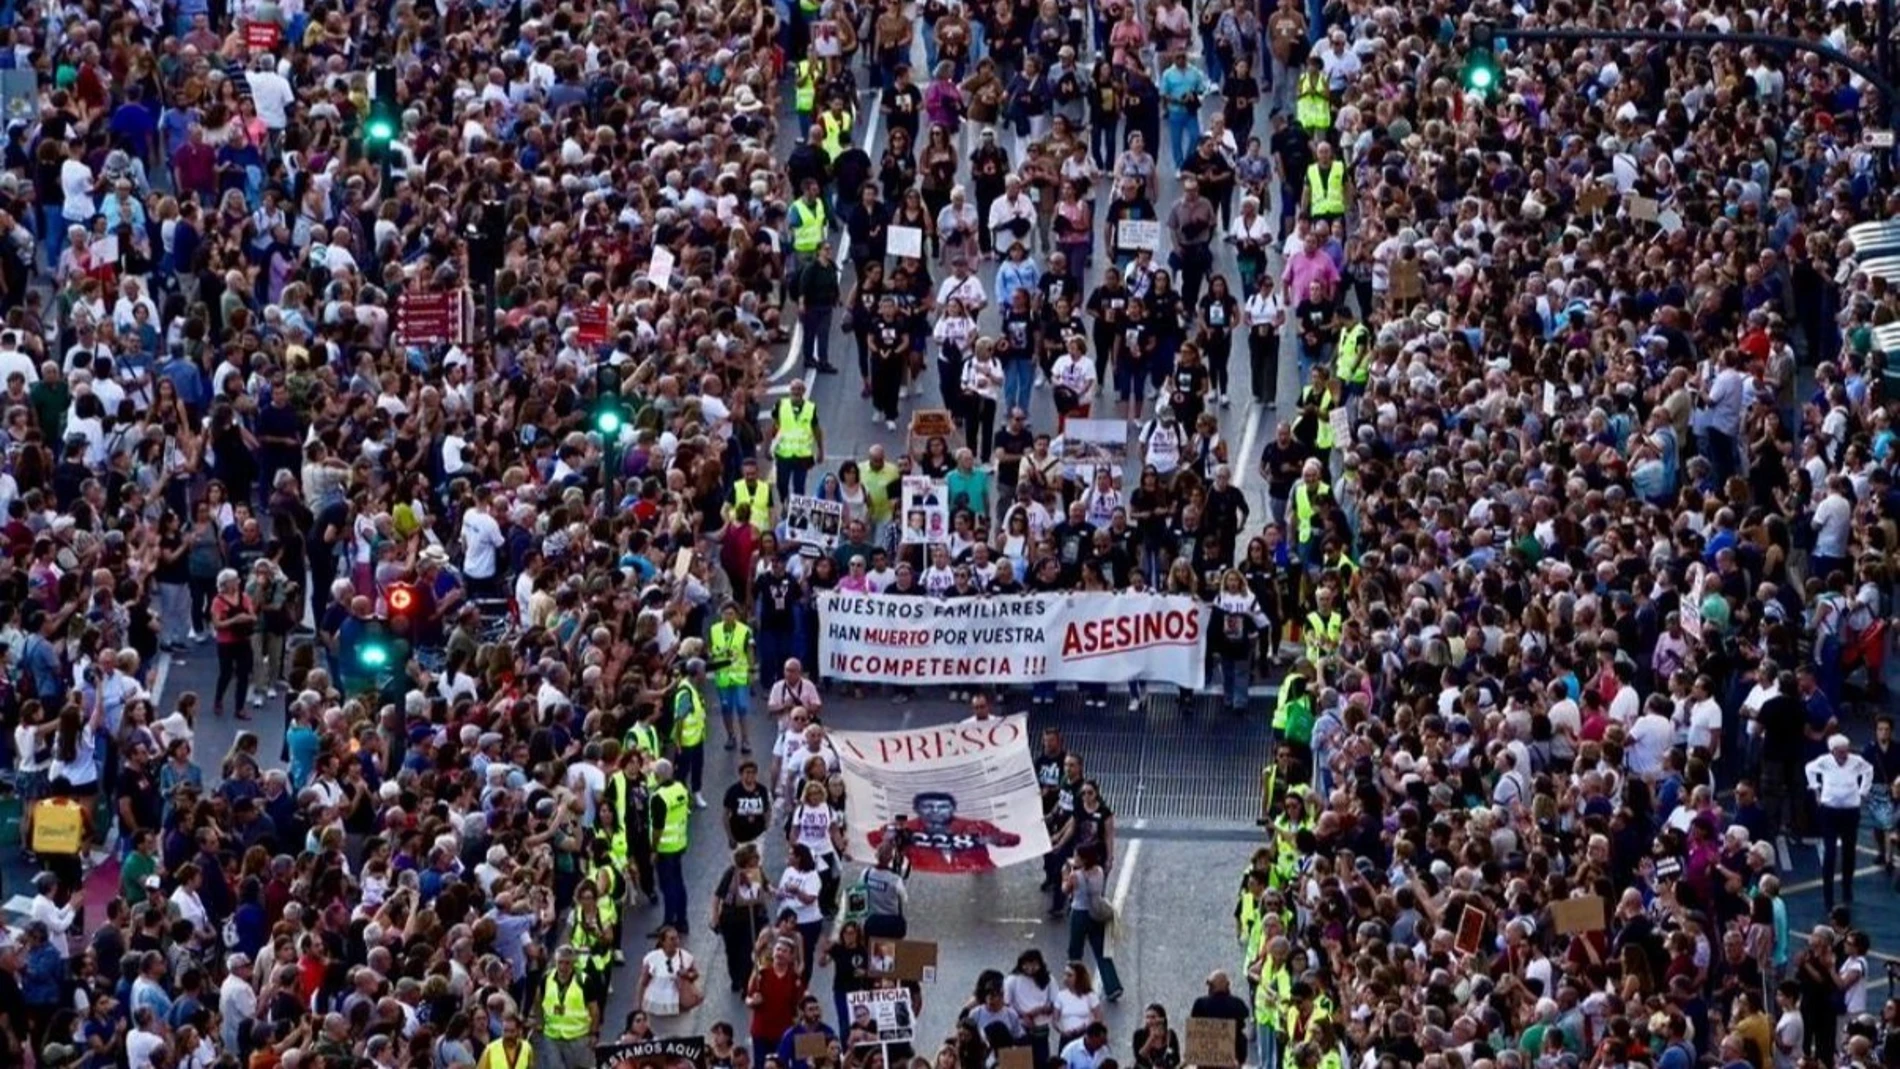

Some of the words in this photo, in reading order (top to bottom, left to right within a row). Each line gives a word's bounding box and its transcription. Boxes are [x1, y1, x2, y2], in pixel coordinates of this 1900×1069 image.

[828, 597, 923, 618] NUESTROS
[933, 600, 1046, 617] FAMILIARES
[829, 623, 860, 642] HAN
[863, 627, 930, 646] MUERTO
[933, 628, 967, 645] POR
[972, 626, 1046, 644] VUESTRA
[1062, 609, 1200, 657] ASESINOS
[829, 652, 1012, 676] INCOMPETENCIA
[1023, 656, 1047, 675] !!!
[911, 831, 974, 849] 228
[848, 989, 908, 1005] JUSTICIA
